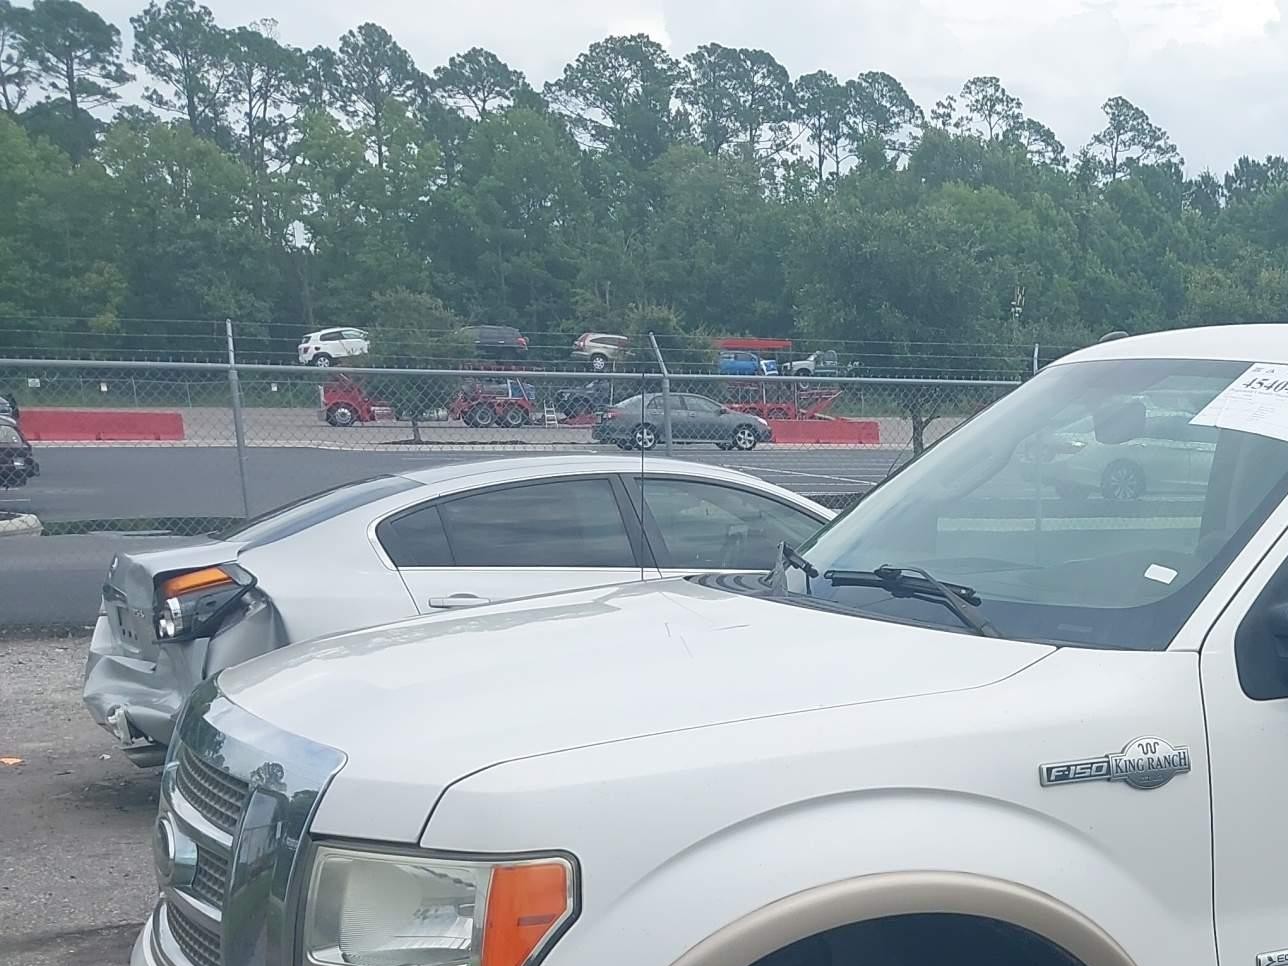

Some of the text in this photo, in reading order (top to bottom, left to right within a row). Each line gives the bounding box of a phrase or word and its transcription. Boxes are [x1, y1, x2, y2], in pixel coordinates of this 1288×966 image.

[1050, 751, 1188, 781] F-150 KING RANCH
